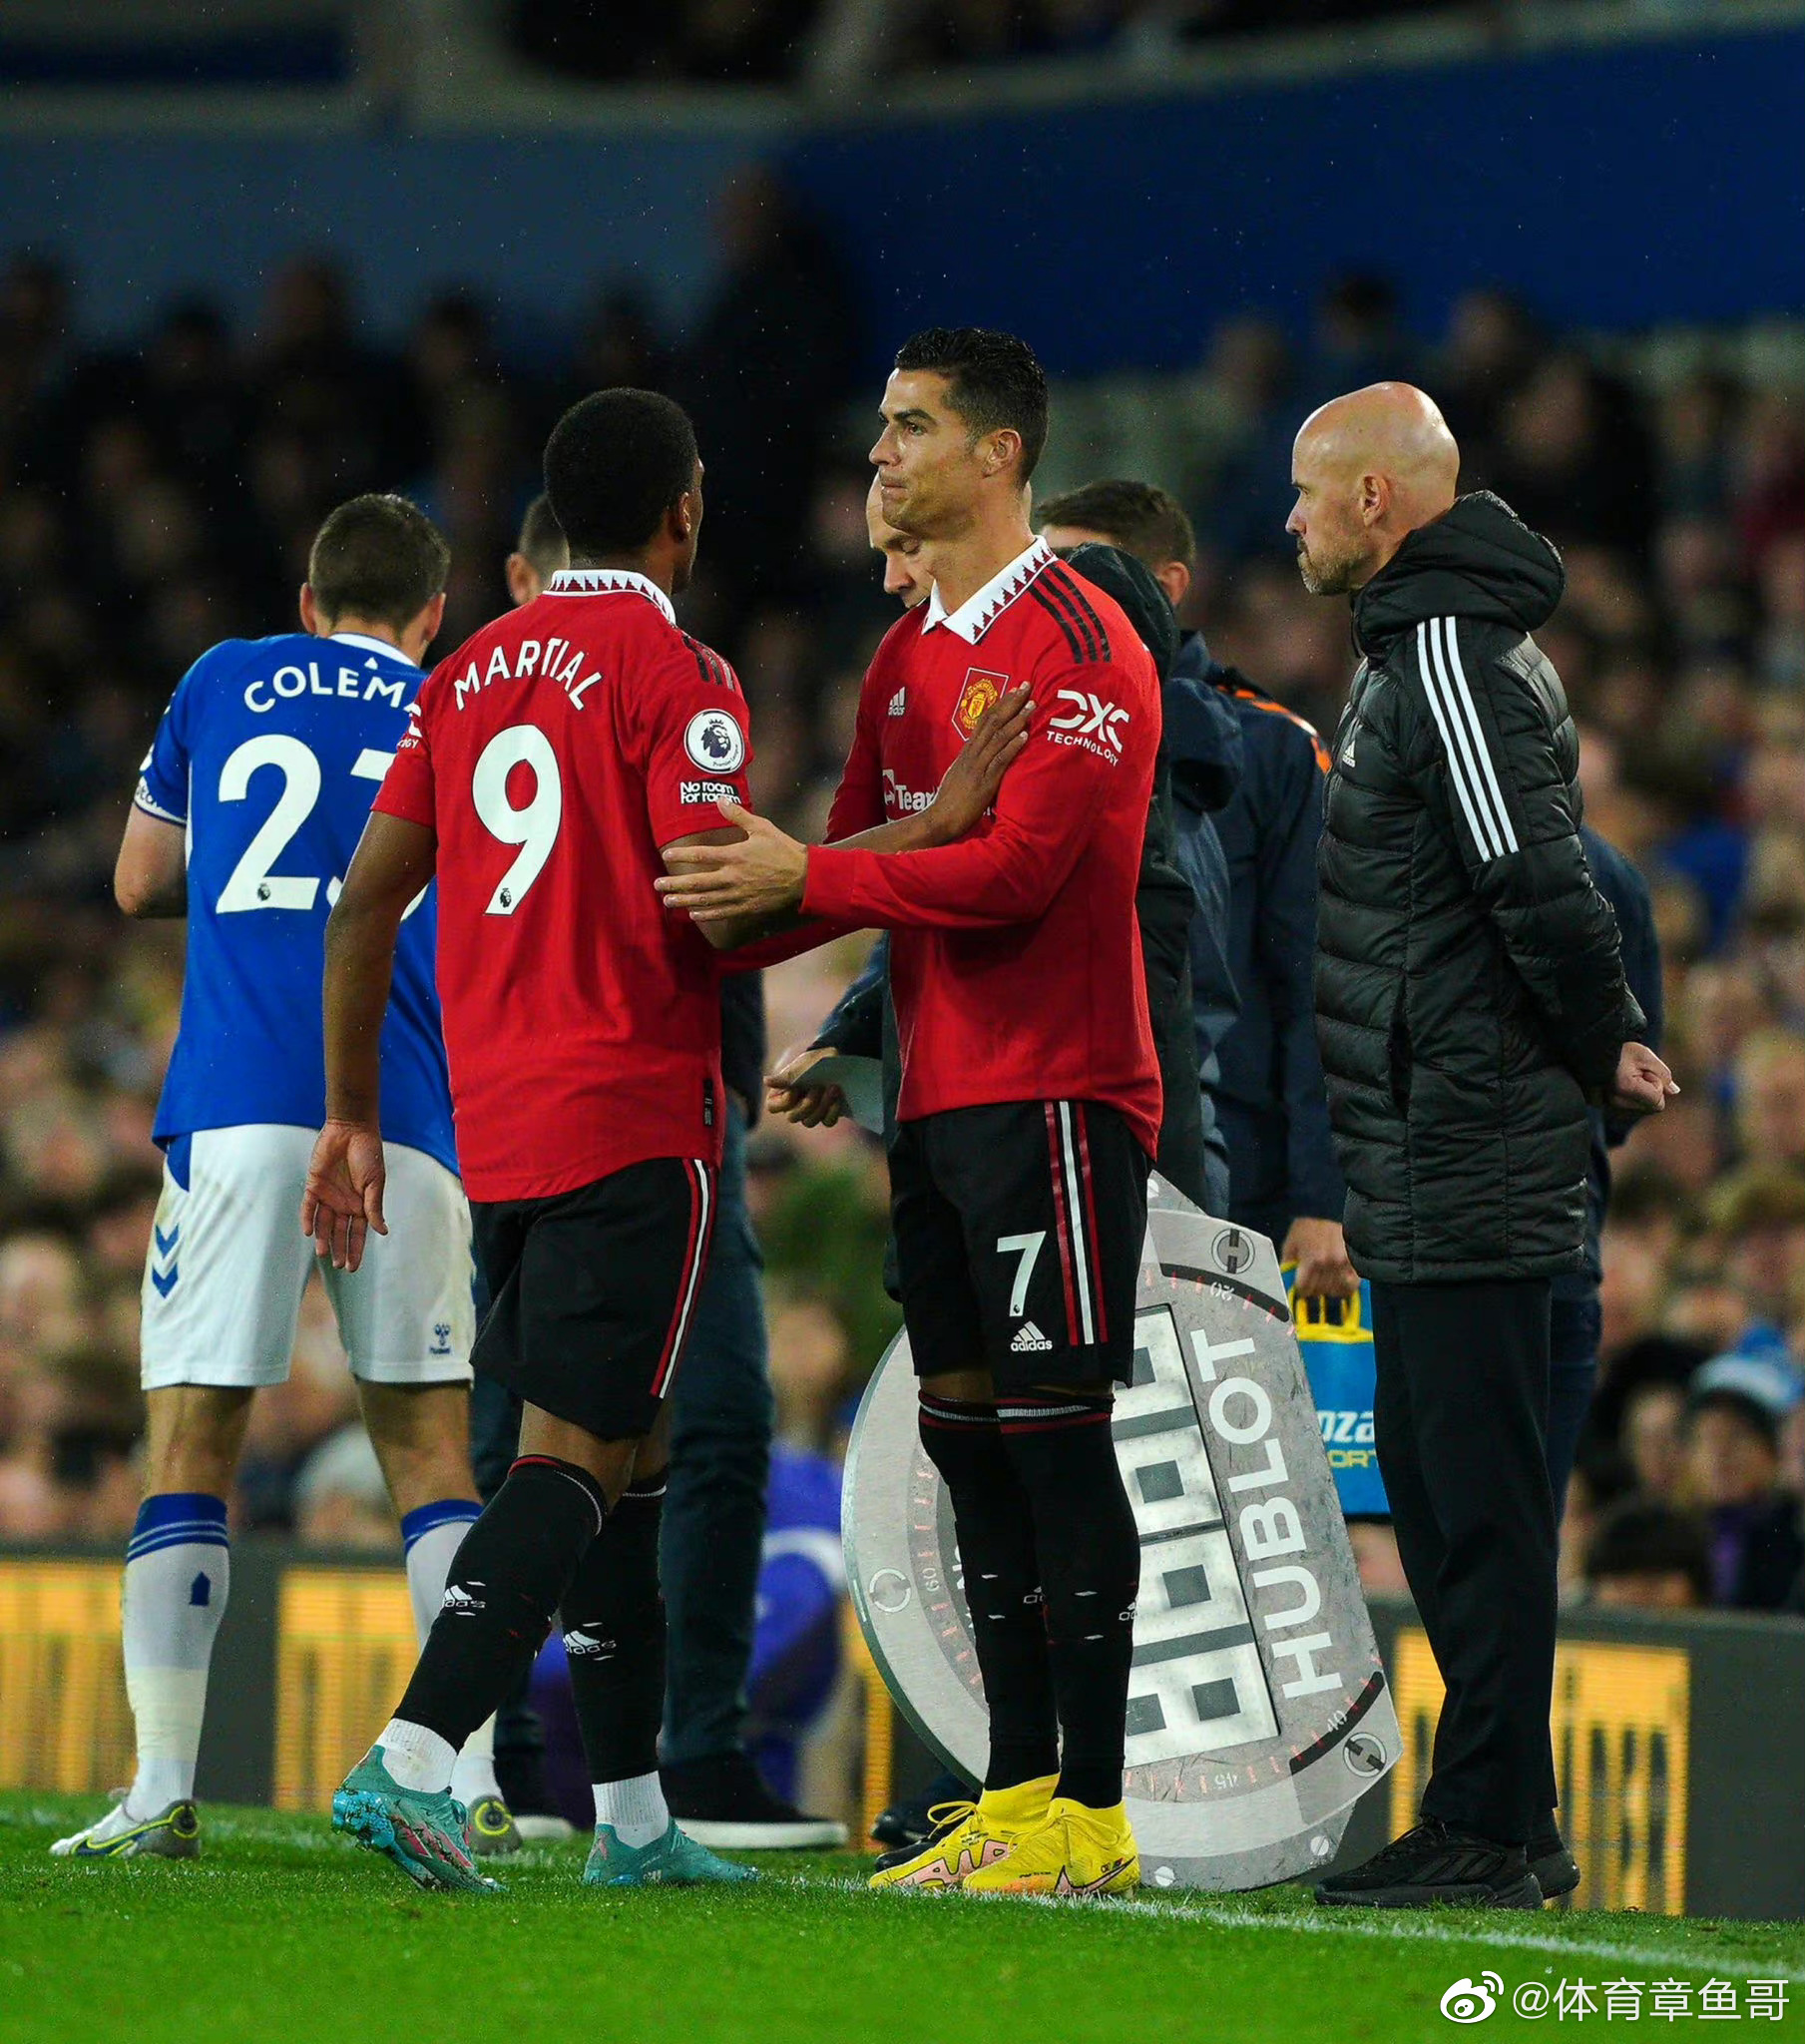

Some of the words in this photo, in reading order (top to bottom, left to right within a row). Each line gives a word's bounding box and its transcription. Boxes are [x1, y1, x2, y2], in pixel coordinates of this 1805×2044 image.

[454, 638, 603, 711] MARTIAL
[472, 724, 563, 915] 9
[680, 781, 700, 793] No
[702, 781, 734, 794] room
[997, 1231, 1046, 1316] 7
[1011, 1339, 1053, 1351] adidas
[1190, 1329, 1343, 1698] HUBLOT
